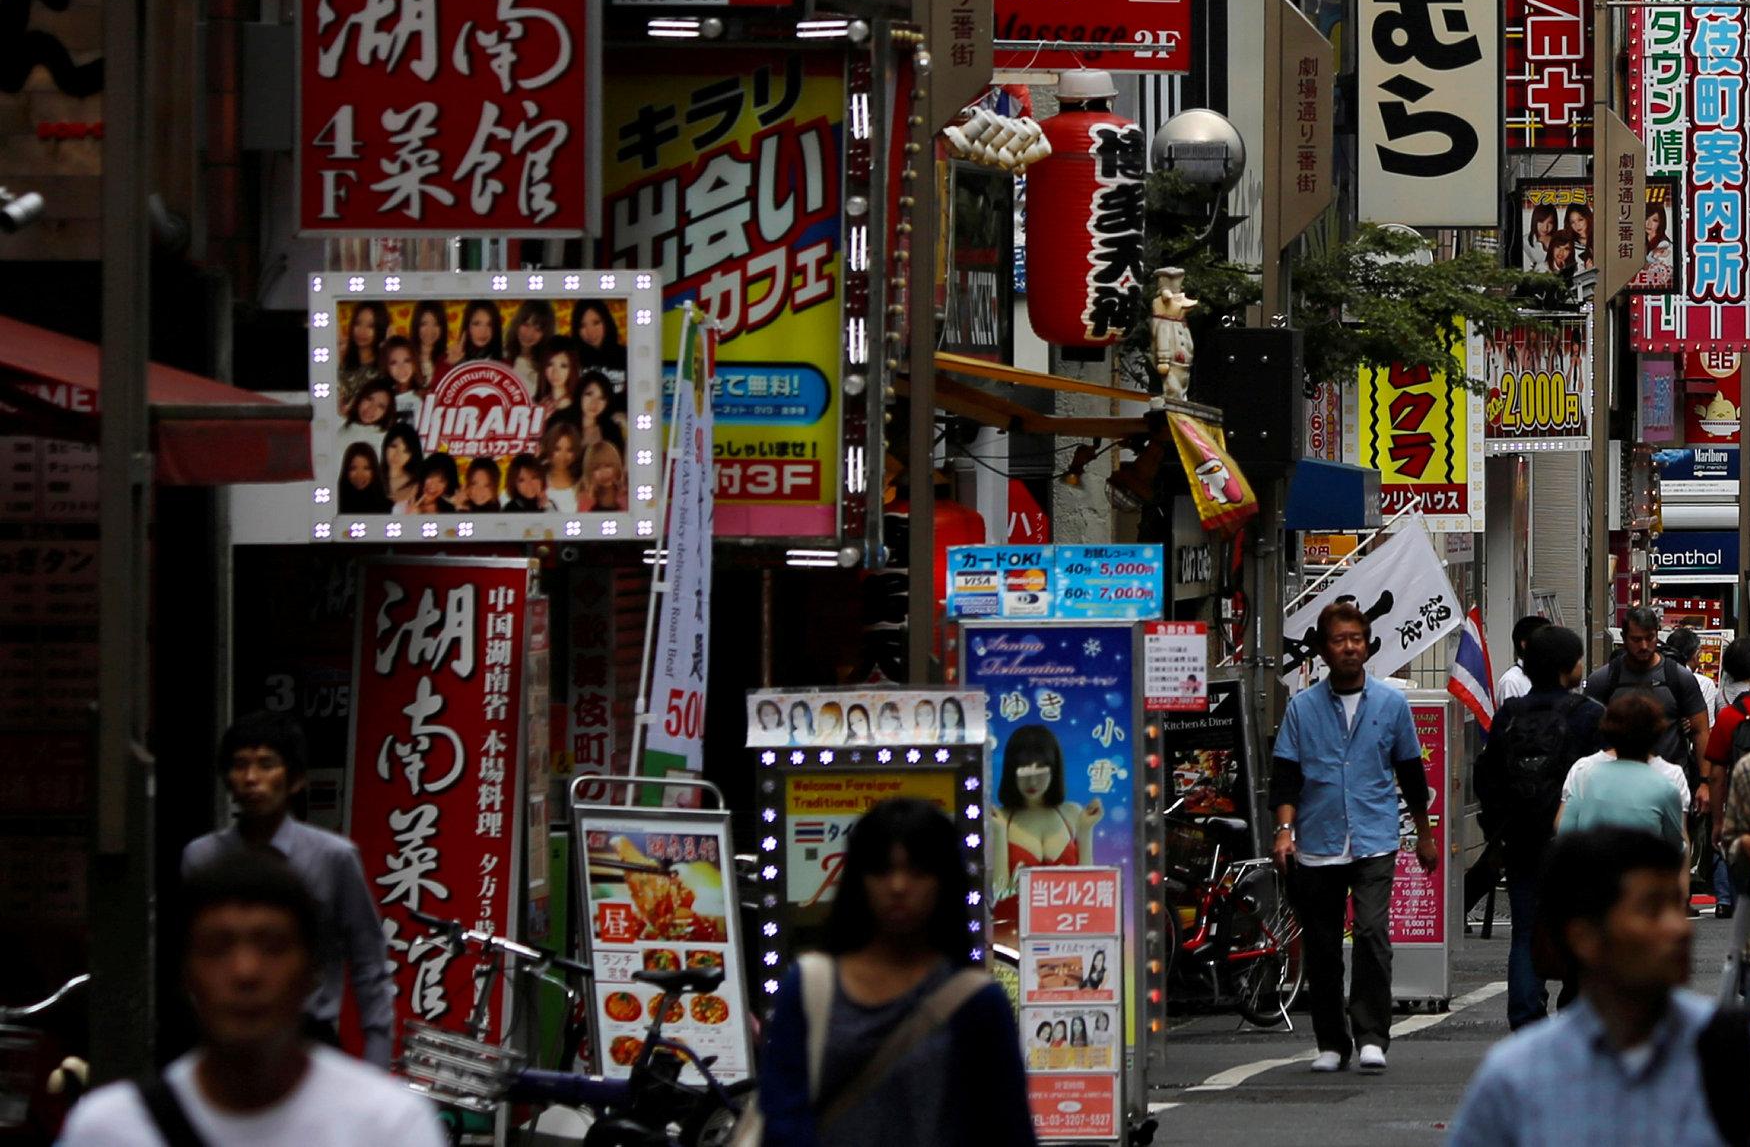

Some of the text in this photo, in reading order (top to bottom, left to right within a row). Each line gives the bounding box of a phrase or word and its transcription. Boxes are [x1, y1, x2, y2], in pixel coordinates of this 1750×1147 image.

[1133, 30, 1182, 59] 2F
[618, 58, 805, 171] キラリ
[1296, 56, 1319, 194] 劇場通り一番街
[1618, 153, 1635, 260] 劇場通り一番街
[418, 393, 544, 452] KIRARI
[1500, 371, 1582, 433] 2,000円
[1693, 448, 1729, 463] Marlboro
[963, 576, 992, 586] VISA
[1031, 880, 1115, 908] 当ビル2階
[1056, 913, 1090, 932] 2F
